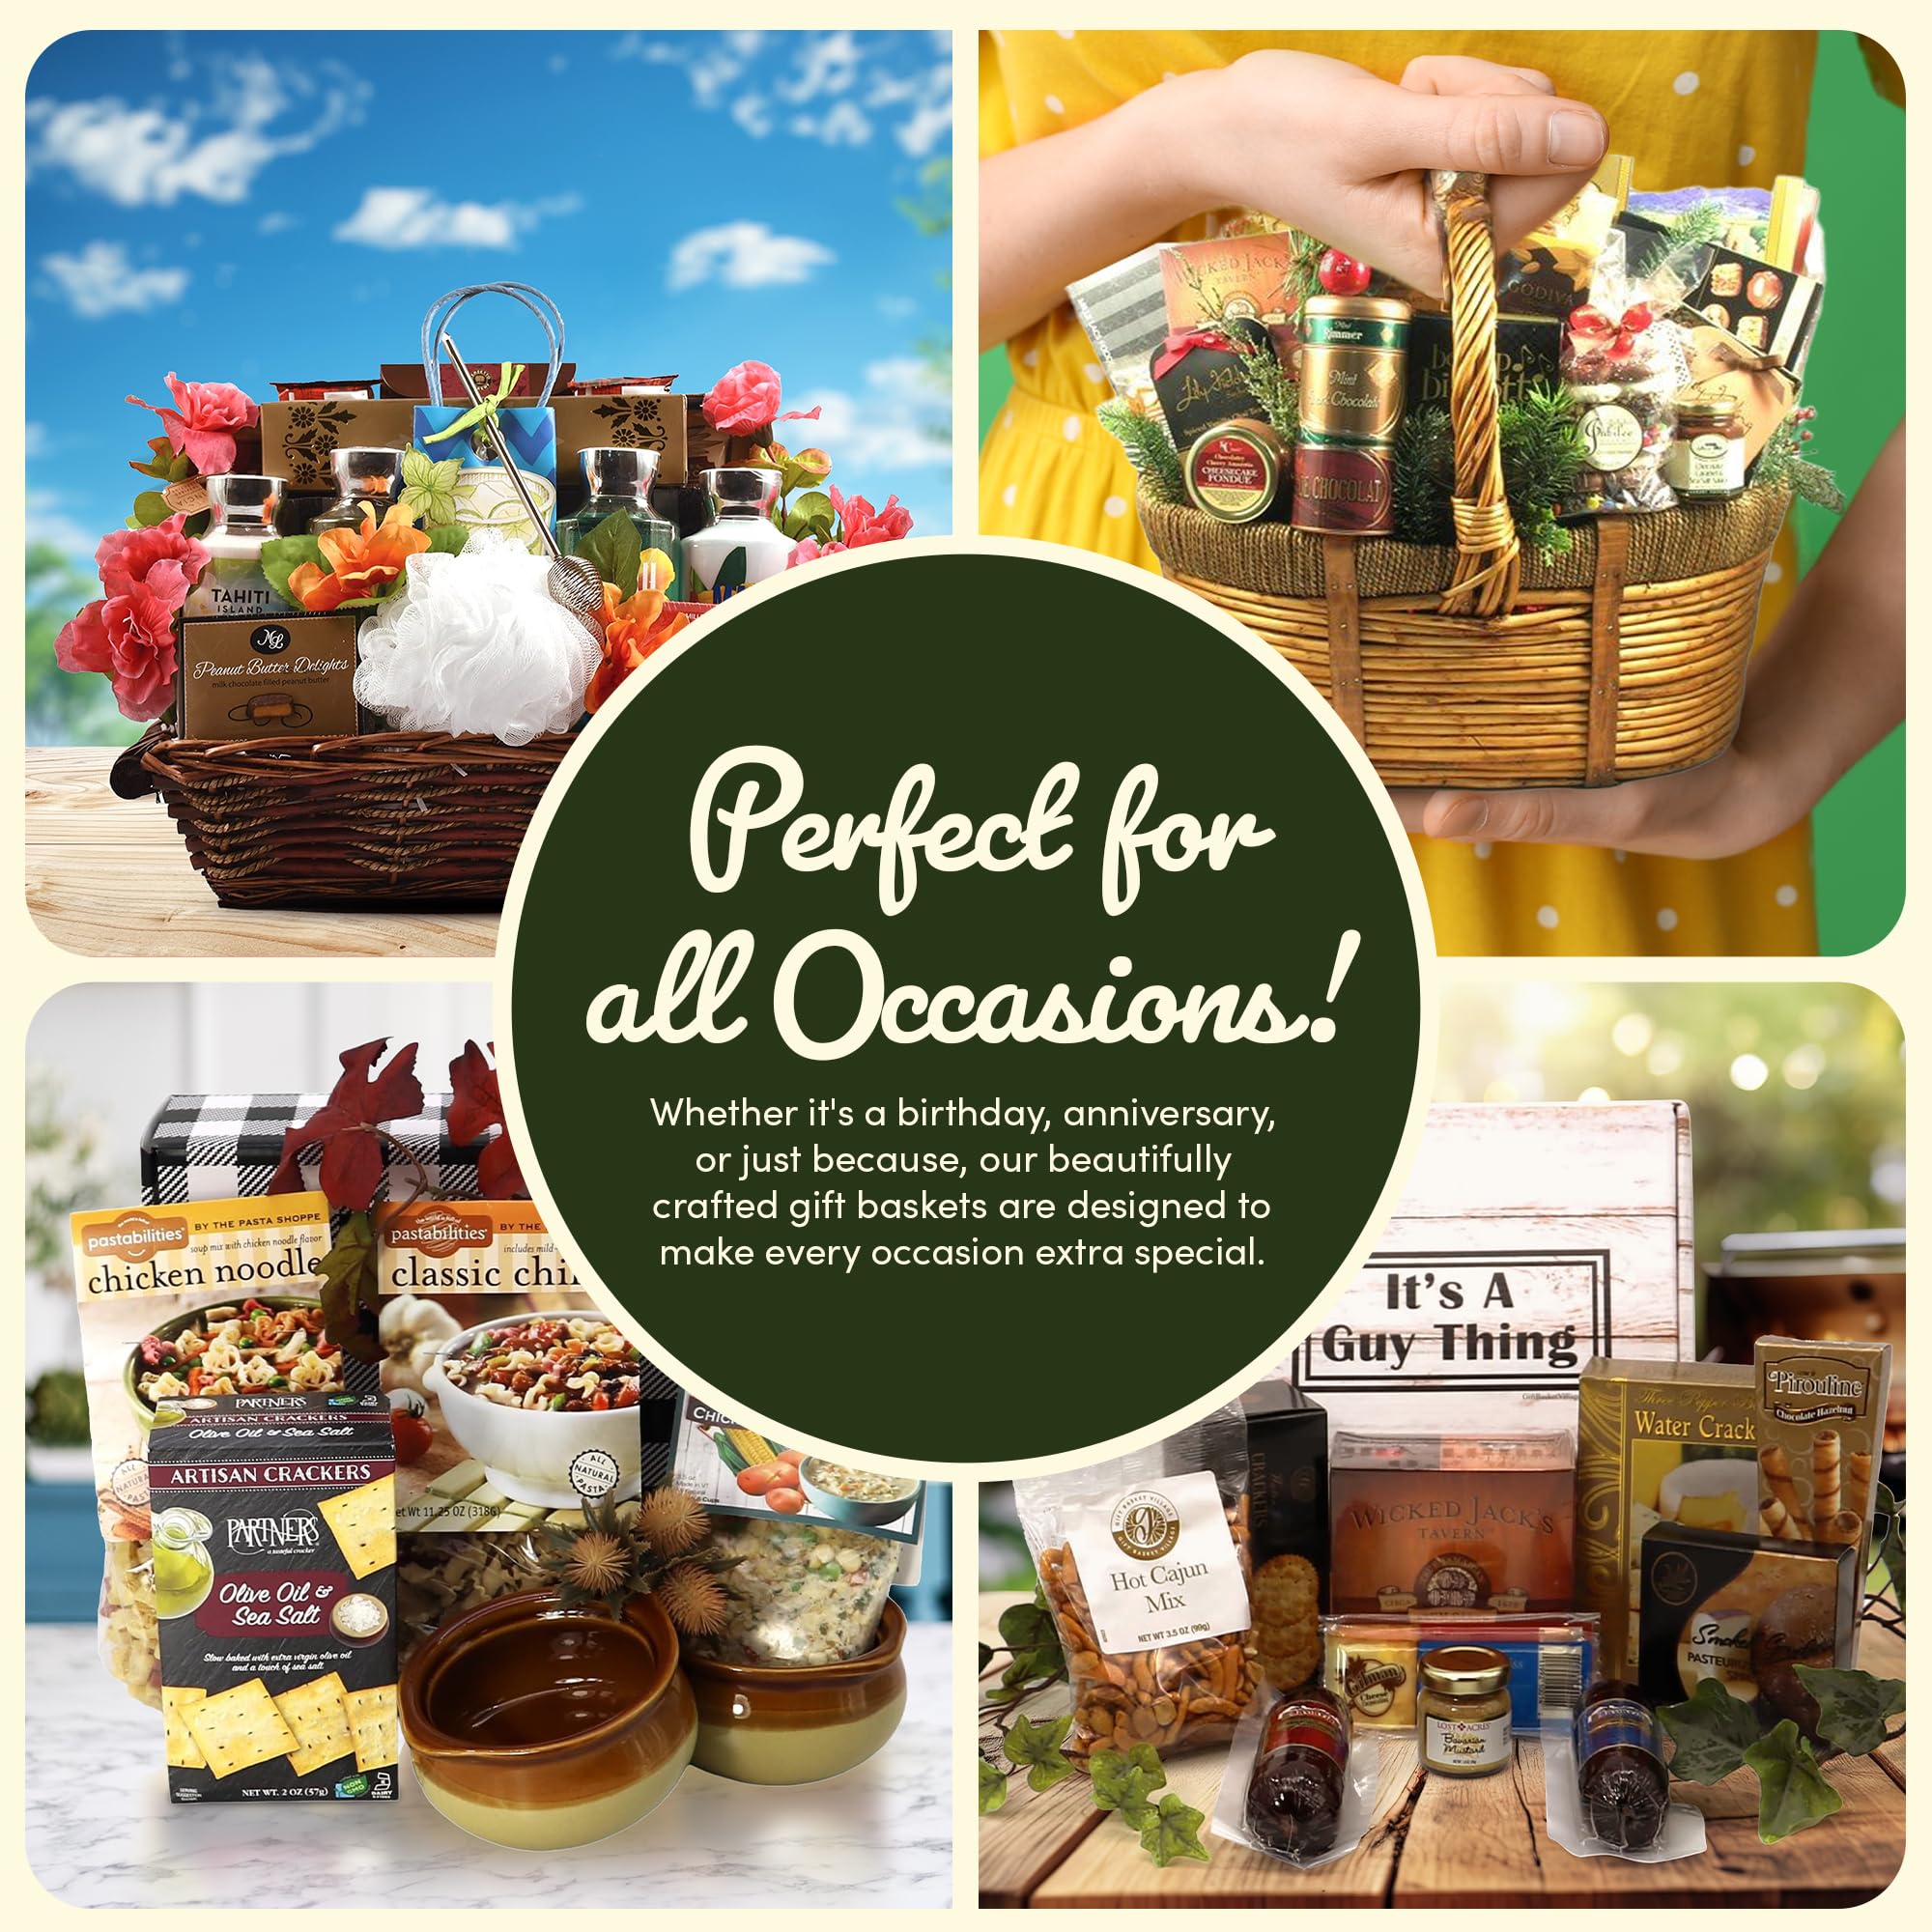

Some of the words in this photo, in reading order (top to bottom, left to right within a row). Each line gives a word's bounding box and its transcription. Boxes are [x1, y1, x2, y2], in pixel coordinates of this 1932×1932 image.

[1507, 279, 1573, 303] GODIVA
[1208, 473, 1253, 485] FONDUE
[1311, 475, 1381, 502] CHOCOLAT
[211, 588, 270, 605] TAHITI
[217, 605, 263, 614] ISLAND
[193, 661, 244, 680] Peanut
[246, 658, 290, 675] Butter
[294, 656, 350, 675] Delights
[212, 680, 227, 689] milk
[228, 679, 262, 688] chocolate
[263, 678, 280, 687] filled
[282, 678, 307, 687] peanut
[307, 676, 329, 685] butter
[194, 1223, 209, 1232] BY
[213, 1220, 235, 1230] THE
[239, 1217, 273, 1228] PASTA
[276, 1213, 322, 1224] SHOPPE
[88, 1227, 182, 1252] pastabilities
[390, 1224, 485, 1244] pastabilities
[190, 1244, 209, 1256] soup
[210, 1242, 224, 1251] mix
[225, 1239, 242, 1250] with
[242, 1237, 270, 1248] chicken
[272, 1235, 298, 1246] noodle
[299, 1233, 323, 1247] flavor
[503, 1243, 534, 1254] includes
[88, 1260, 204, 1294] chicken
[216, 1247, 322, 1283] noodle
[391, 1256, 502, 1287] classic
[514, 1255, 580, 1287] chi
[1386, 1272, 1464, 1310] It's
[1483, 1271, 1515, 1309] A
[1321, 1324, 1416, 1371] Guy
[1433, 1322, 1578, 1370] Thing
[1768, 1370, 1862, 1398] Pirouline
[235, 1397, 307, 1409] PARTNERS
[189, 1414, 259, 1425] ARTISAN
[263, 1413, 348, 1423] CRACKERS
[694, 1406, 734, 1425] CHIC
[1634, 1409, 1691, 1437] Water
[1699, 1414, 1756, 1440] Crack
[1776, 1408, 1817, 1422] Chocolate
[188, 1429, 231, 1439] Olive
[235, 1428, 262, 1438] Oil
[281, 1428, 315, 1438] Sea
[317, 1426, 355, 1437] Salt
[121, 1463, 135, 1475] ALL
[590, 1455, 606, 1465] ALL
[116, 1473, 149, 1492] NATURA
[170, 1466, 258, 1485] ARTISAN
[264, 1463, 371, 1483] CRACKERS
[574, 1463, 614, 1484] NATURAL
[576, 1478, 605, 1493] PASTA
[128, 1491, 149, 1502] PAST
[395, 1507, 407, 1517] et
[408, 1506, 422, 1517] Wt
[423, 1506, 450, 1517] 11.25
[452, 1506, 466, 1517] OZ
[468, 1505, 501, 1519] (318G)
[1351, 1500, 1461, 1531] WICKED
[1465, 1496, 1554, 1534] JACK'S
[227, 1514, 320, 1548] PARTNERS
[1417, 1527, 1486, 1540] TAVERN
[1111, 1571, 1148, 1592] Hot
[1150, 1561, 1208, 1586] Cajun
[219, 1582, 271, 1605] Olive
[276, 1581, 311, 1604] Oil
[315, 1585, 333, 1599] &
[1144, 1591, 1187, 1614] Mix
[232, 1605, 272, 1626] Sea
[275, 1605, 322, 1625] Salt
[1137, 1634, 1151, 1643] NET
[1152, 1632, 1165, 1641] WT
[1166, 1629, 1179, 1638] 3.5
[1179, 1627, 1190, 1636] OZ
[1190, 1622, 1210, 1634] (99g)
[203, 1652, 224, 1662] Slow
[225, 1652, 250, 1662] baked
[251, 1651, 270, 1662] with
[270, 1652, 293, 1662] extra
[294, 1652, 319, 1664] virgin
[319, 1650, 338, 1661] olive
[340, 1649, 353, 1660] oil
[231, 1662, 248, 1672] and
[257, 1662, 281, 1672] touch
[281, 1662, 291, 1674] of
[307, 1661, 325, 1671] salt
[1346, 1667, 1399, 1695] Gilman
[1359, 1692, 1388, 1701] Cheese
[1436, 1721, 1456, 1731] LOST
[1465, 1722, 1491, 1732] ACRES
[1440, 1732, 1487, 1745] Bavarian
[1442, 1744, 1486, 1755] Mustard
[242, 1788, 261, 1797] NET
[262, 1788, 280, 1797] WT.
[281, 1788, 288, 1797] 2
[289, 1788, 303, 1797] OZ
[304, 1787, 328, 1797] (57g)
[343, 1778, 362, 1791] NON
[346, 1784, 365, 1795] GMO
